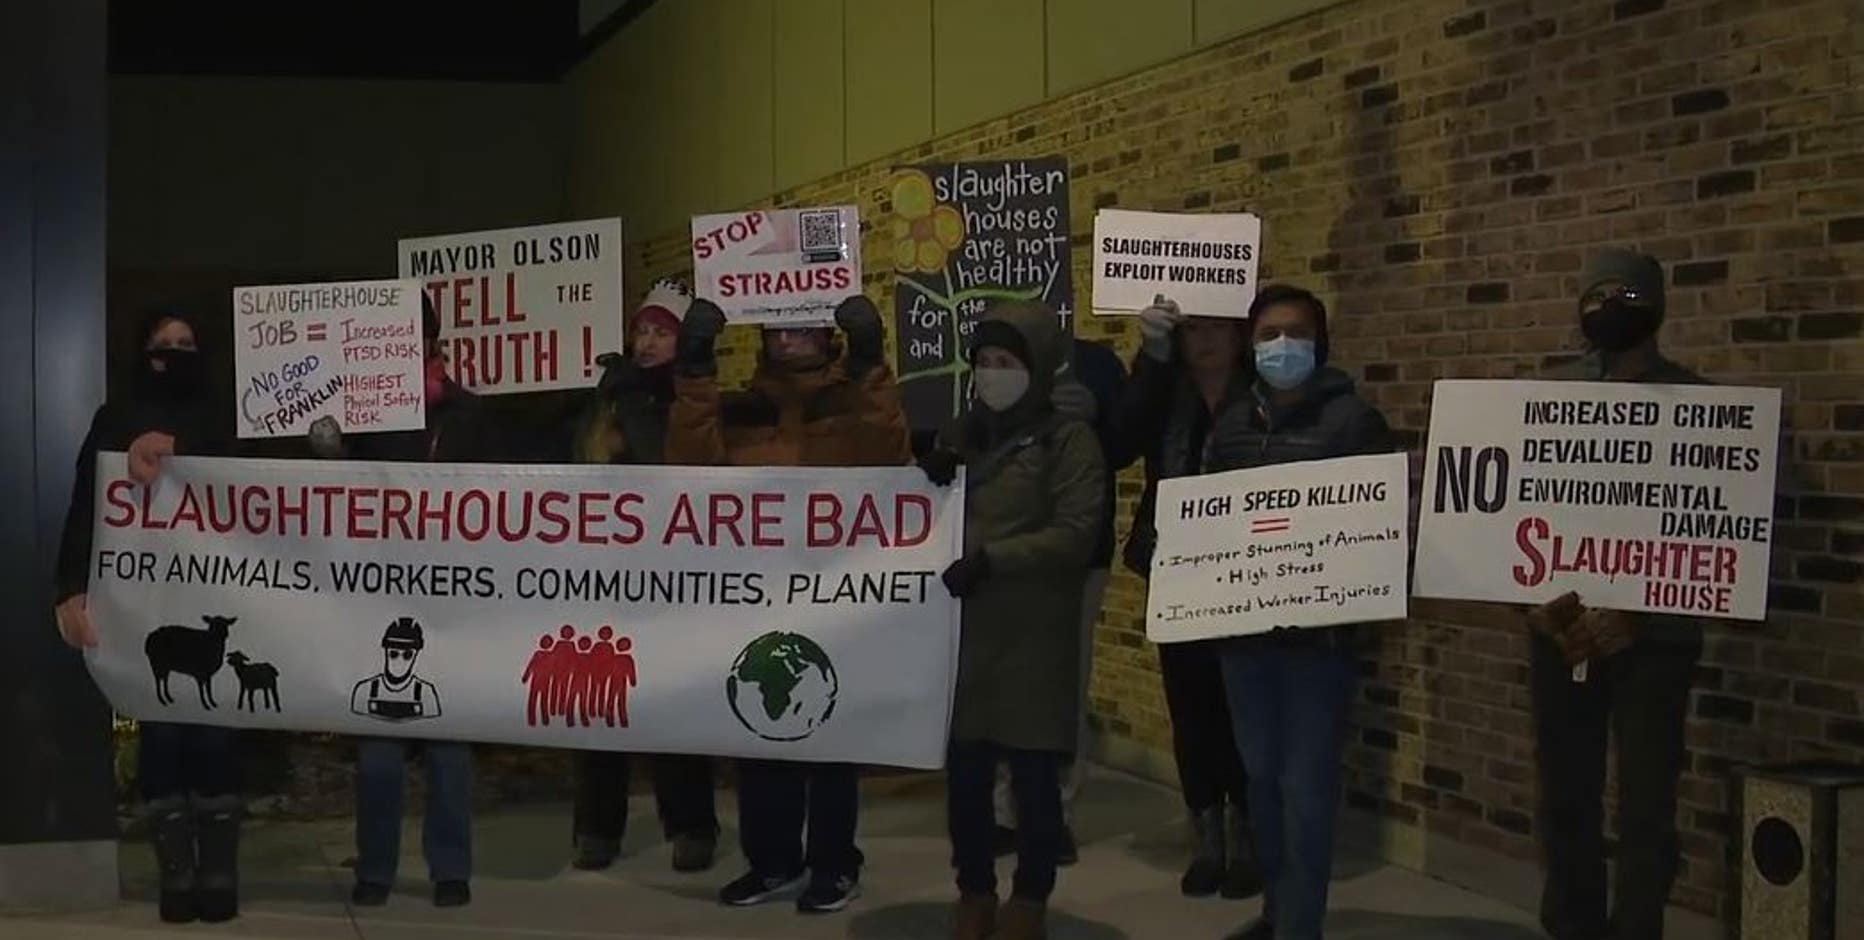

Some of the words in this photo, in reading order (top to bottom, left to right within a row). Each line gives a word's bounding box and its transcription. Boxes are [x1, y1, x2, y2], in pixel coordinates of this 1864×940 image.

[936, 162, 1064, 211] slaughter
[962, 202, 1058, 235] houses
[694, 212, 763, 259] STOP
[965, 238, 1005, 262] are
[1017, 232, 1067, 260] not
[1102, 237, 1252, 261] SLAUGHTERHOUSES
[410, 243, 496, 277] MAYOR
[513, 233, 600, 267] OLSON
[719, 267, 850, 297] STRAUSS
[956, 254, 1060, 300] healthy
[1104, 261, 1166, 282] EXPLOIT
[1169, 265, 1246, 286] WORKERS
[240, 288, 404, 315] SLAUGHTERHOUSE
[426, 272, 527, 329] TELL
[557, 283, 593, 304] THE
[907, 294, 948, 328] for
[248, 319, 298, 349] JOB
[340, 317, 416, 344] Increased
[910, 333, 943, 359] and
[343, 345, 381, 363] PTSD
[385, 342, 420, 360] RISK
[438, 329, 558, 388] RUTH
[251, 371, 278, 398] NO
[282, 355, 319, 382] GOOD
[343, 373, 406, 393] HIGHEST
[264, 375, 343, 434] FRANKLIN
[274, 382, 307, 406] FOR
[345, 410, 383, 427] RISK
[1524, 401, 1660, 427] INCREASED
[1673, 403, 1755, 430] CRIME
[1522, 439, 1653, 465] DEVALUED
[1670, 442, 1761, 472] HOMES
[1433, 446, 1510, 514] NO
[1518, 477, 1728, 511] ENVIRONMENTAL
[104, 479, 645, 546] SLAUGHTERHOUSES
[662, 491, 786, 548] ARE
[806, 492, 932, 549] BAD
[1181, 495, 1231, 520] HIGH
[1243, 488, 1300, 512] SPEED
[1307, 482, 1387, 507] KILLING
[1660, 511, 1770, 543] DAMAGE
[1169, 549, 1241, 567] Improper
[1246, 540, 1314, 559] Stunning
[1318, 533, 1332, 547] of
[1333, 527, 1400, 547] Animals
[1512, 516, 1738, 588] SLAUGHTER
[98, 550, 157, 583] FOR
[516, 567, 773, 607] COMMUNITIES,
[786, 571, 936, 604] PLANET
[1229, 567, 1268, 586] High
[1277, 562, 1324, 578] Stress
[1165, 598, 1251, 621] Increased
[1257, 594, 1311, 610] Worker
[1314, 584, 1391, 606] Injuries
[1644, 581, 1732, 614] HOUSE
